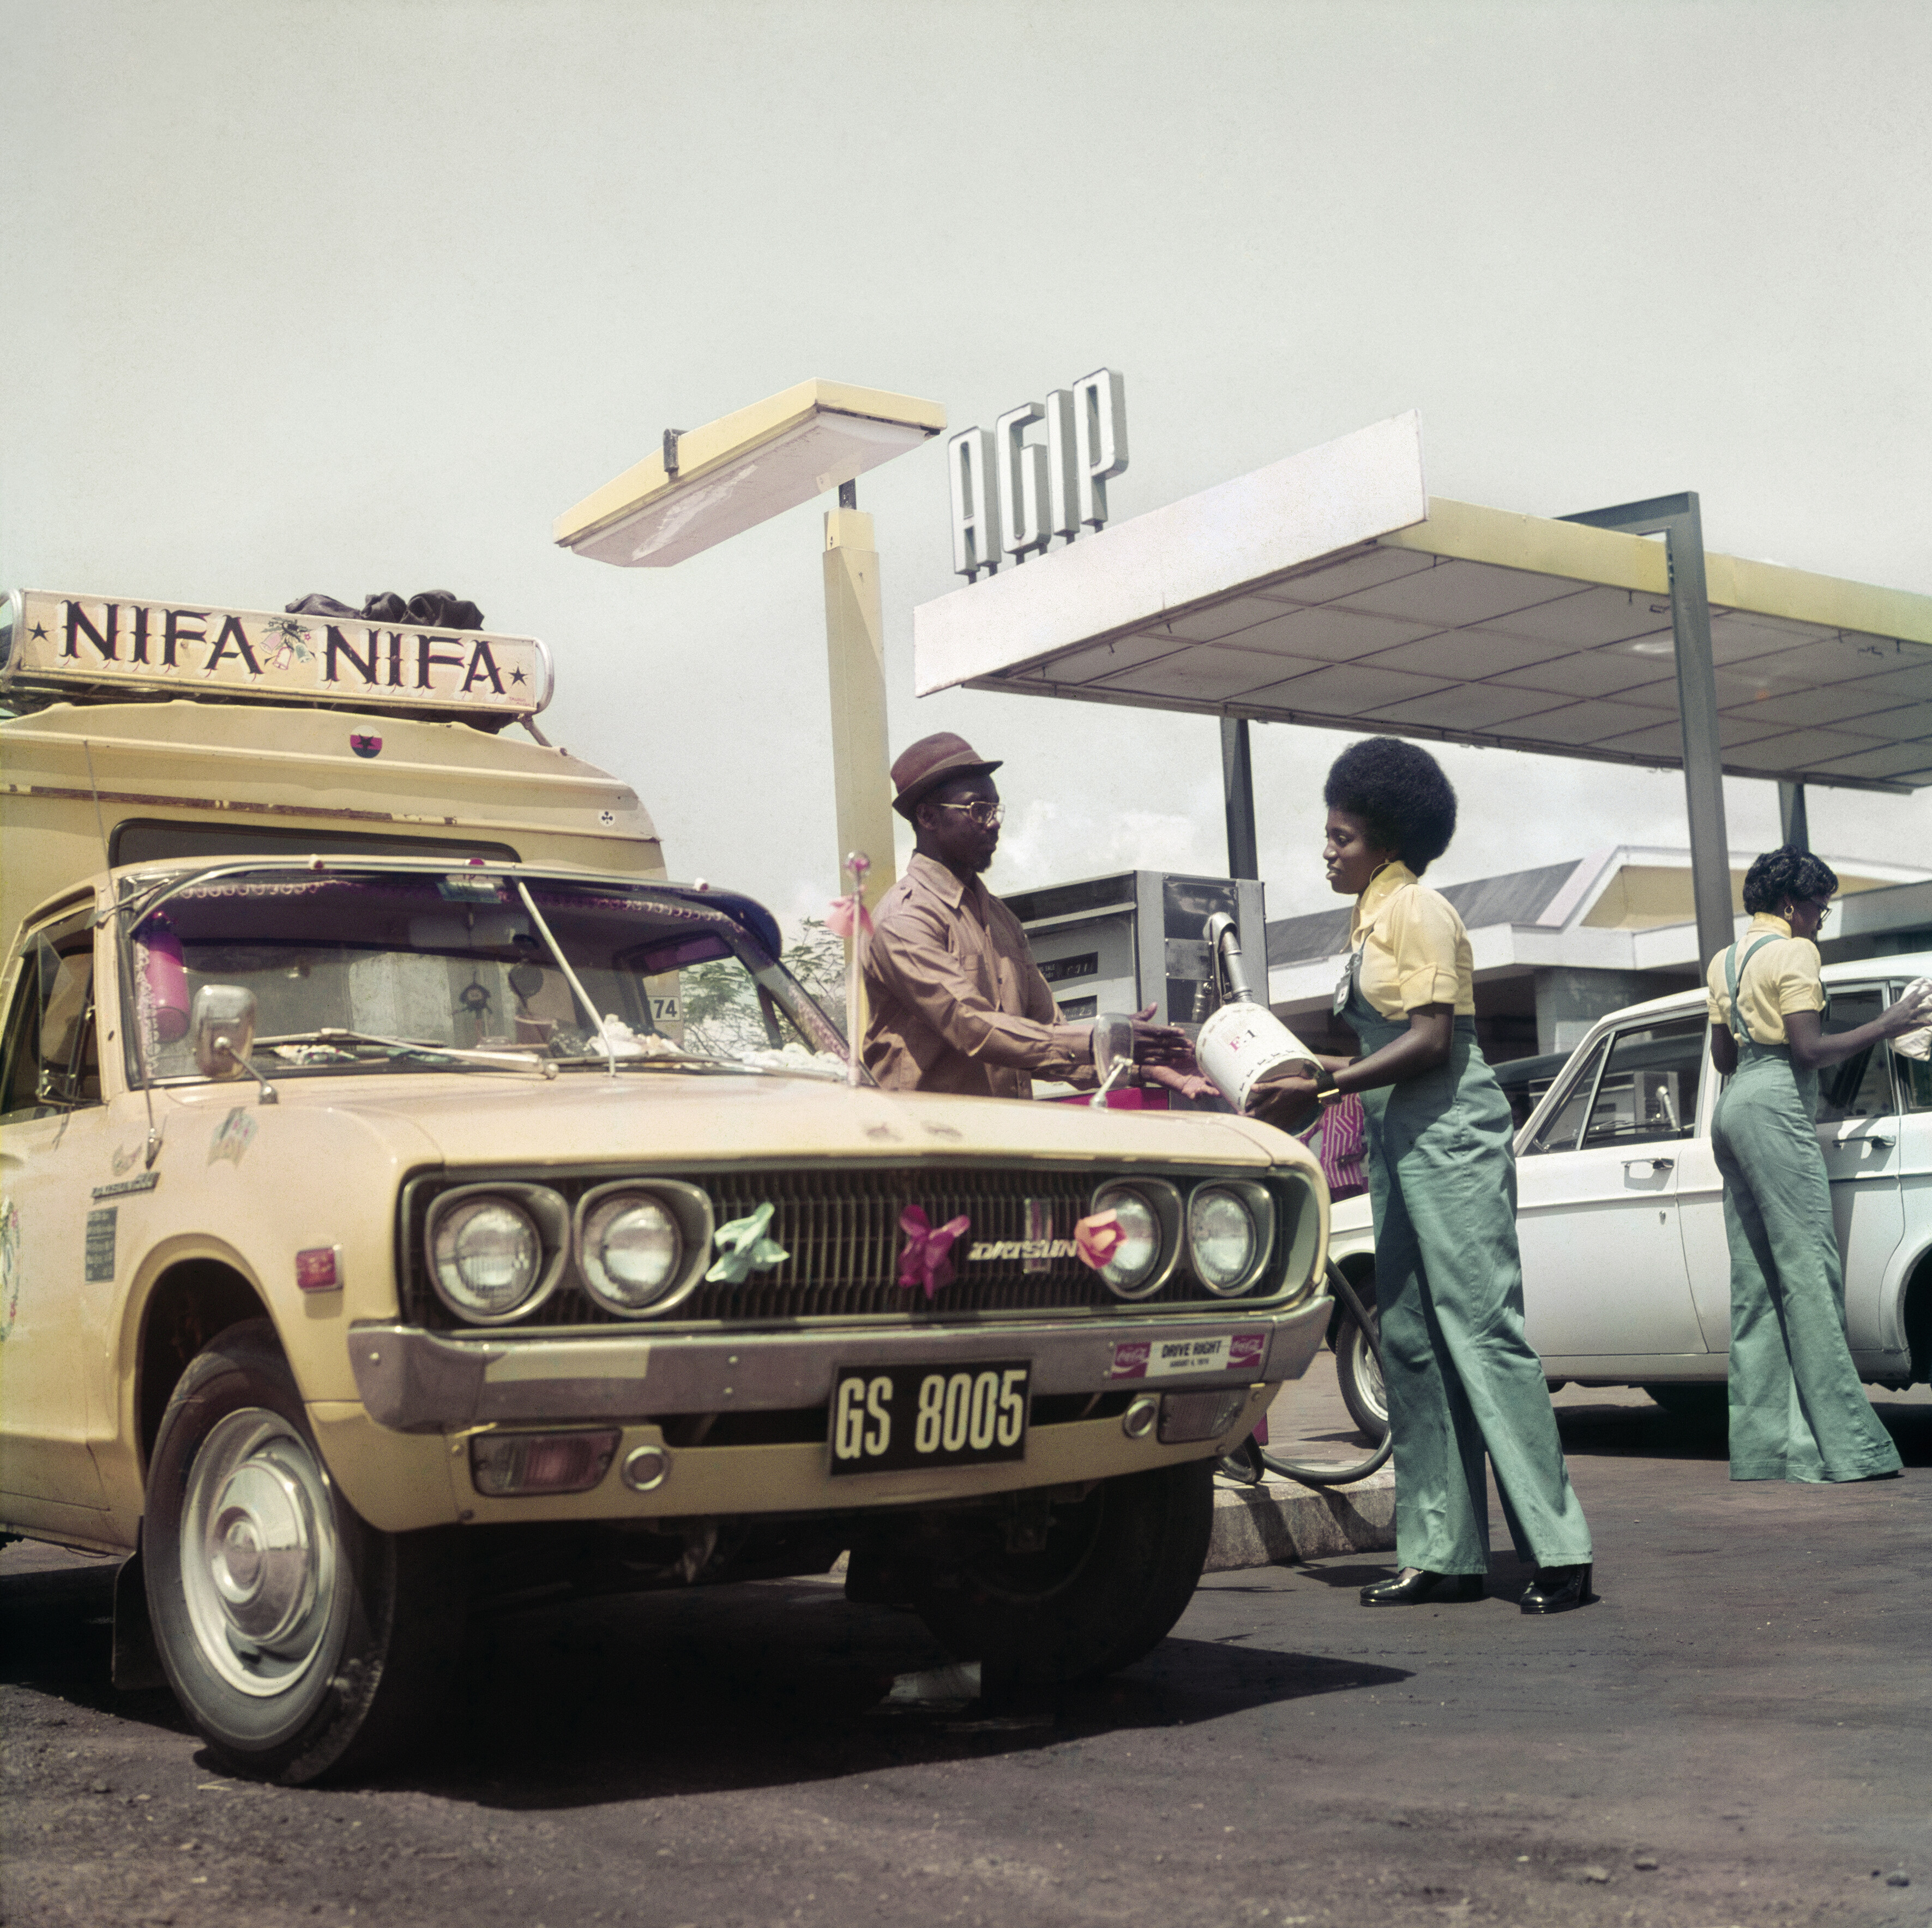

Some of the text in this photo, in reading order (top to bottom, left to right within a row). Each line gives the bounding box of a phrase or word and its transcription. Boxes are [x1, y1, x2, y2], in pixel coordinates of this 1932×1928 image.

[948, 367, 1128, 574] AGIP
[59, 600, 507, 694] NIFA NIFA
[968, 1240, 1076, 1260] DATSUN
[1161, 1340, 1222, 1358] DRIVE RIGHT
[835, 1369, 1027, 1460] GS 8005
